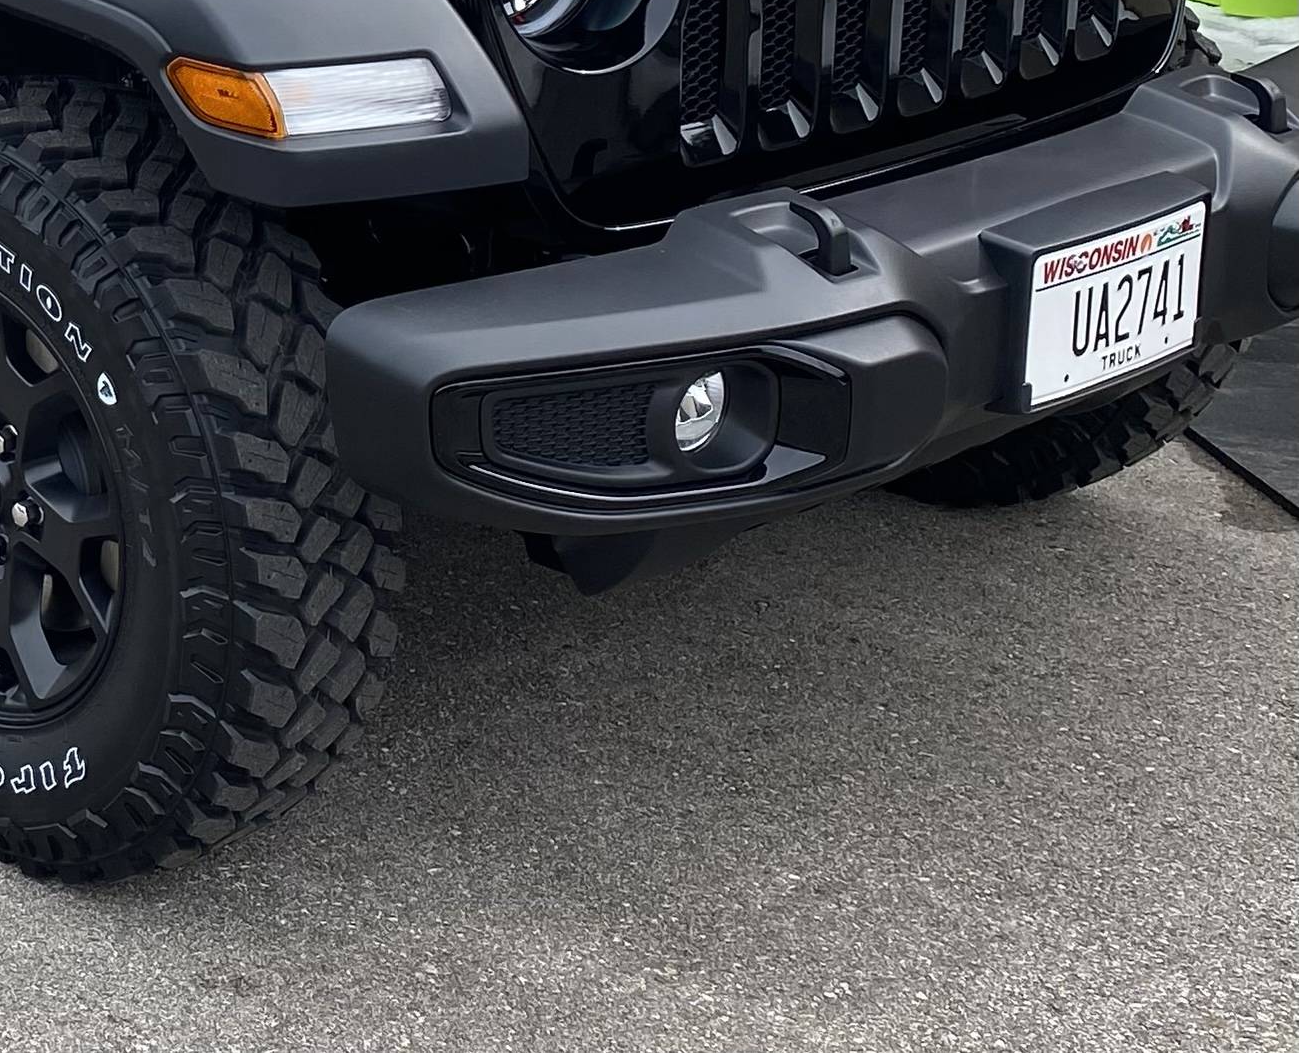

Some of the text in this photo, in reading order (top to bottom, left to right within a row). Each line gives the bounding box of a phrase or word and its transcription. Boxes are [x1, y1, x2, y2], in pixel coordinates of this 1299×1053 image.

[1043, 234, 1140, 285] WISCONSIN
[1072, 253, 1185, 357] UA2741
[1101, 342, 1142, 371] TRUCK
